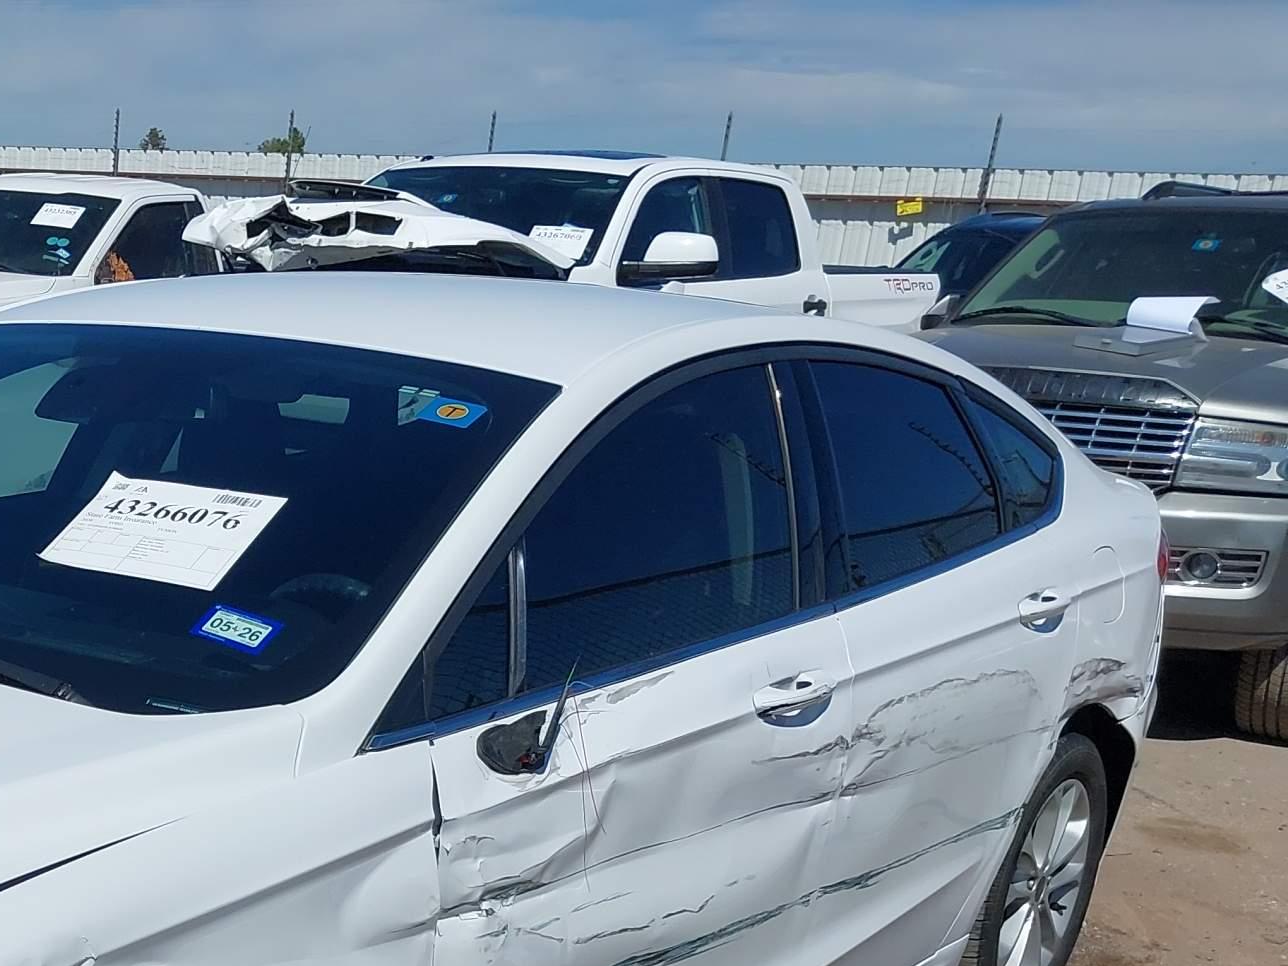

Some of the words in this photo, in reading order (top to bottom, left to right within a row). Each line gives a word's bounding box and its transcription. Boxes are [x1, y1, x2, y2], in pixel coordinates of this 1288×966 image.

[883, 278, 911, 294] TRD
[911, 281, 934, 291] PRO
[104, 498, 248, 530] 43266076
[104, 513, 123, 521] Farm
[123, 516, 158, 526] Insurance
